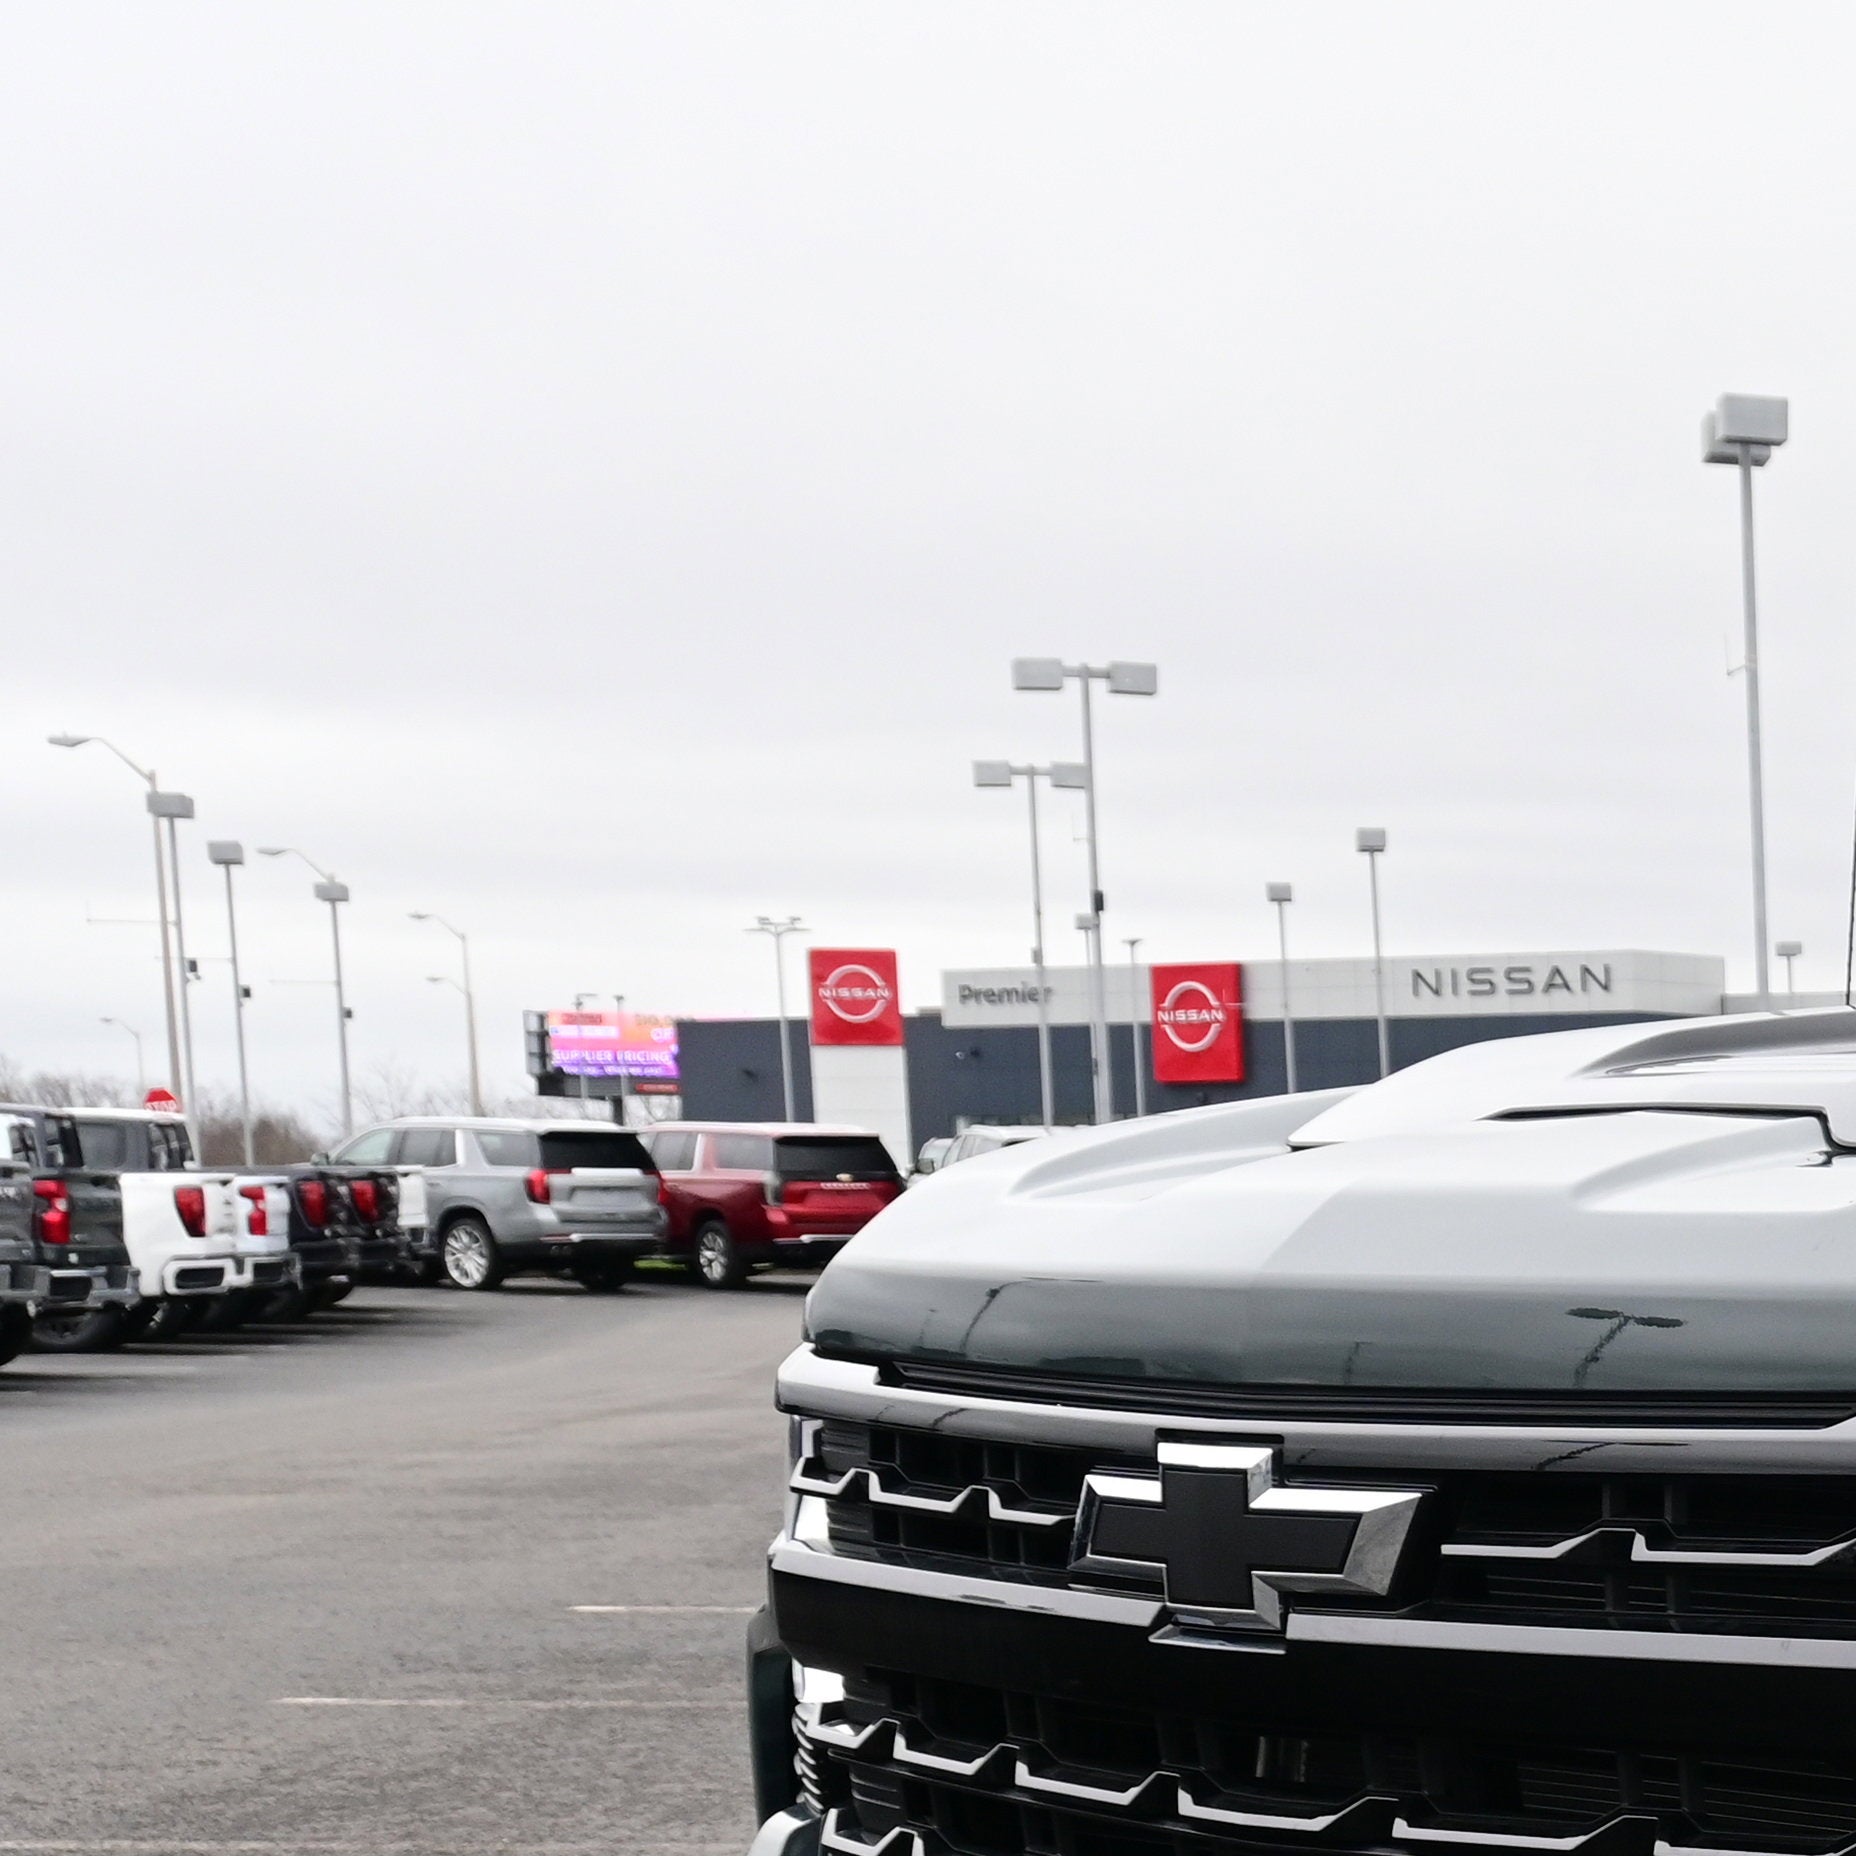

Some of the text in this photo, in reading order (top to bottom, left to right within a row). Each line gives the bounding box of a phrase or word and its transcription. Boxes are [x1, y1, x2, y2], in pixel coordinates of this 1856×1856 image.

[1411, 963, 1613, 997] NISSAN
[818, 987, 890, 1000] NISSAN
[958, 982, 1055, 1005] Premier
[1156, 1008, 1224, 1025] NISSAN
